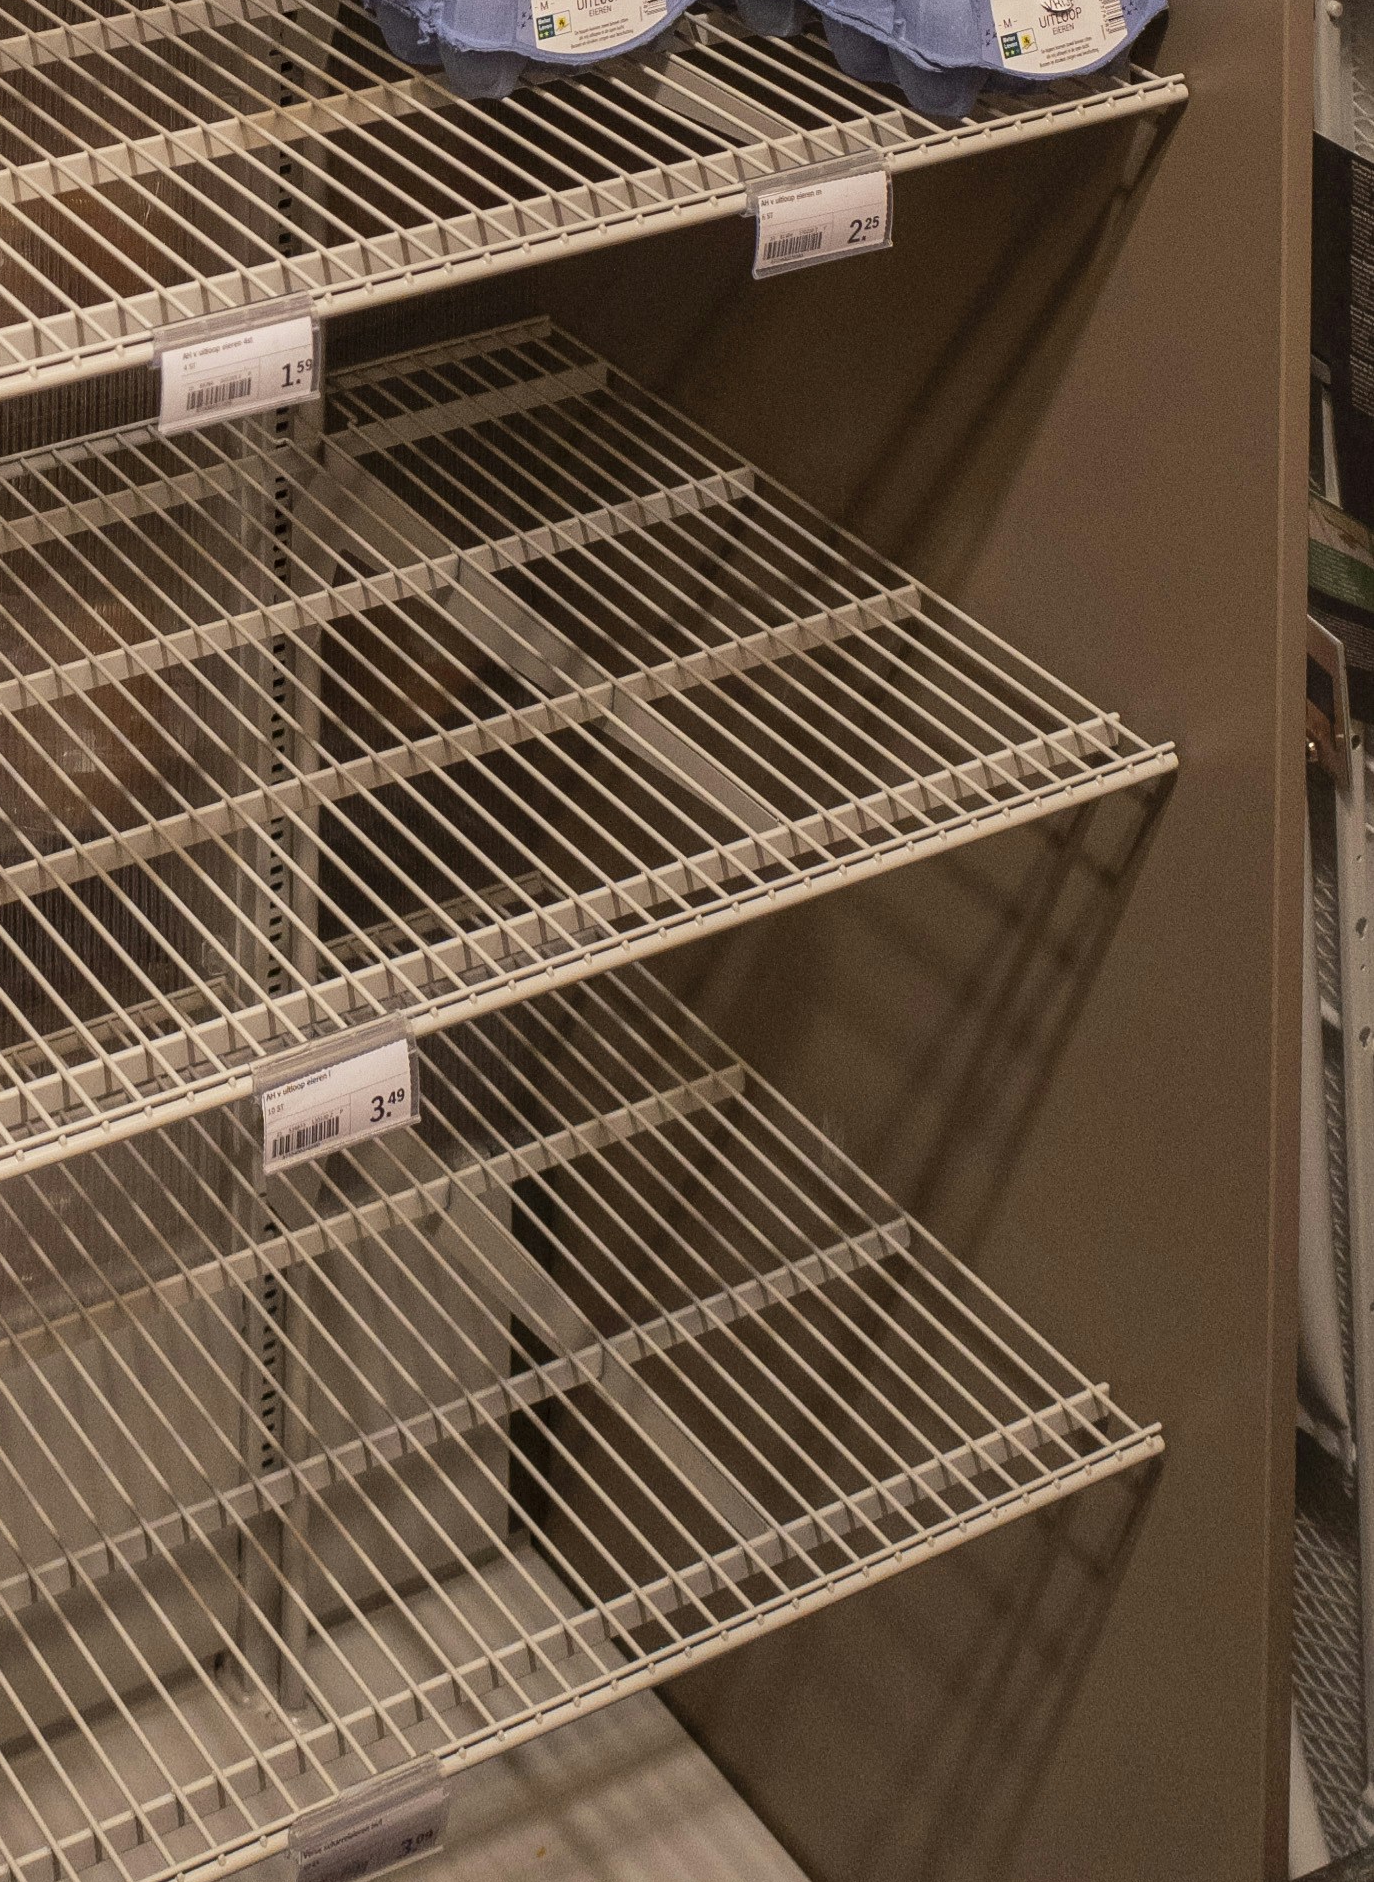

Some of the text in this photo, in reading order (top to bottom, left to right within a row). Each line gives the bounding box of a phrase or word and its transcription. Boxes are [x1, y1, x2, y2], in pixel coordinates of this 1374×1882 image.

[588, 5, 612, 17] EIEREN
[1038, 6, 1082, 29] UITLOOP
[775, 195, 795, 205] uitloop
[796, 191, 815, 201] eieren
[848, 216, 880, 244] 2.25
[282, 359, 312, 388] 1.59
[266, 1075, 328, 1102] AH uitloop eieren
[370, 1088, 405, 1122] 3.49
